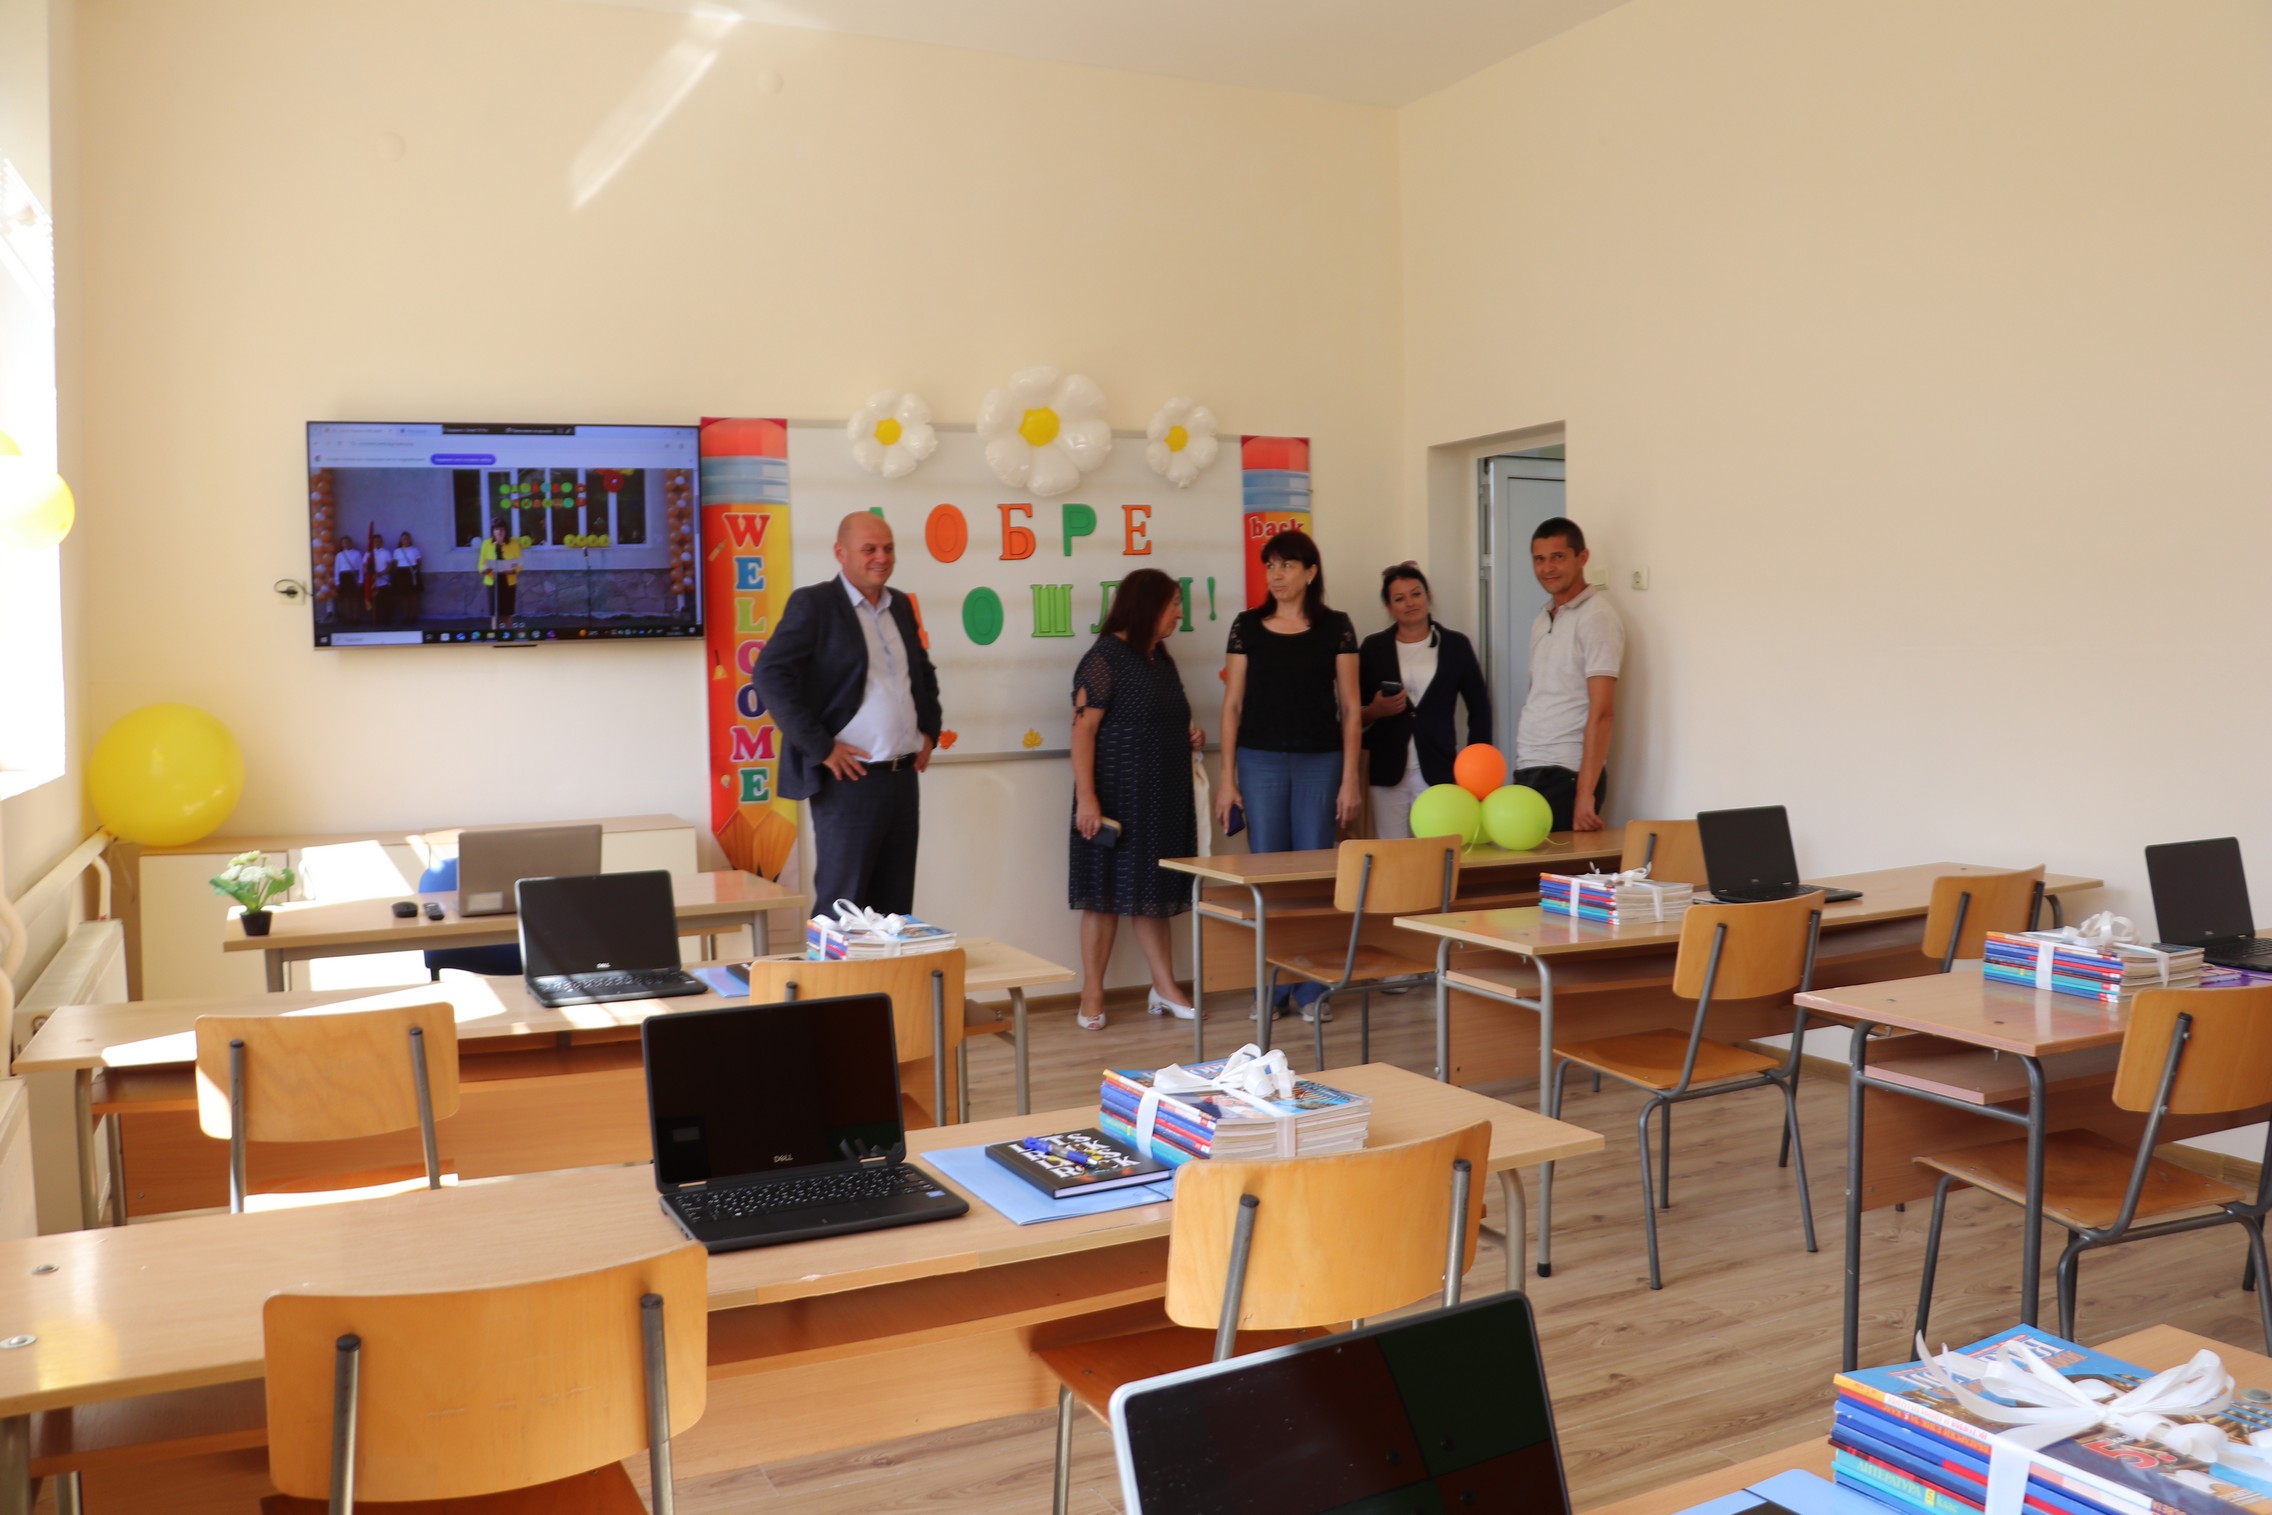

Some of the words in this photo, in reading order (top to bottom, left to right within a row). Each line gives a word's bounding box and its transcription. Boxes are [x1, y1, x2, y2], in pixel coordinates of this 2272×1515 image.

[868, 503, 1152, 563] ОБРЕ
[722, 512, 776, 802] WELCOME
[773, 1153, 794, 1164] DELL
